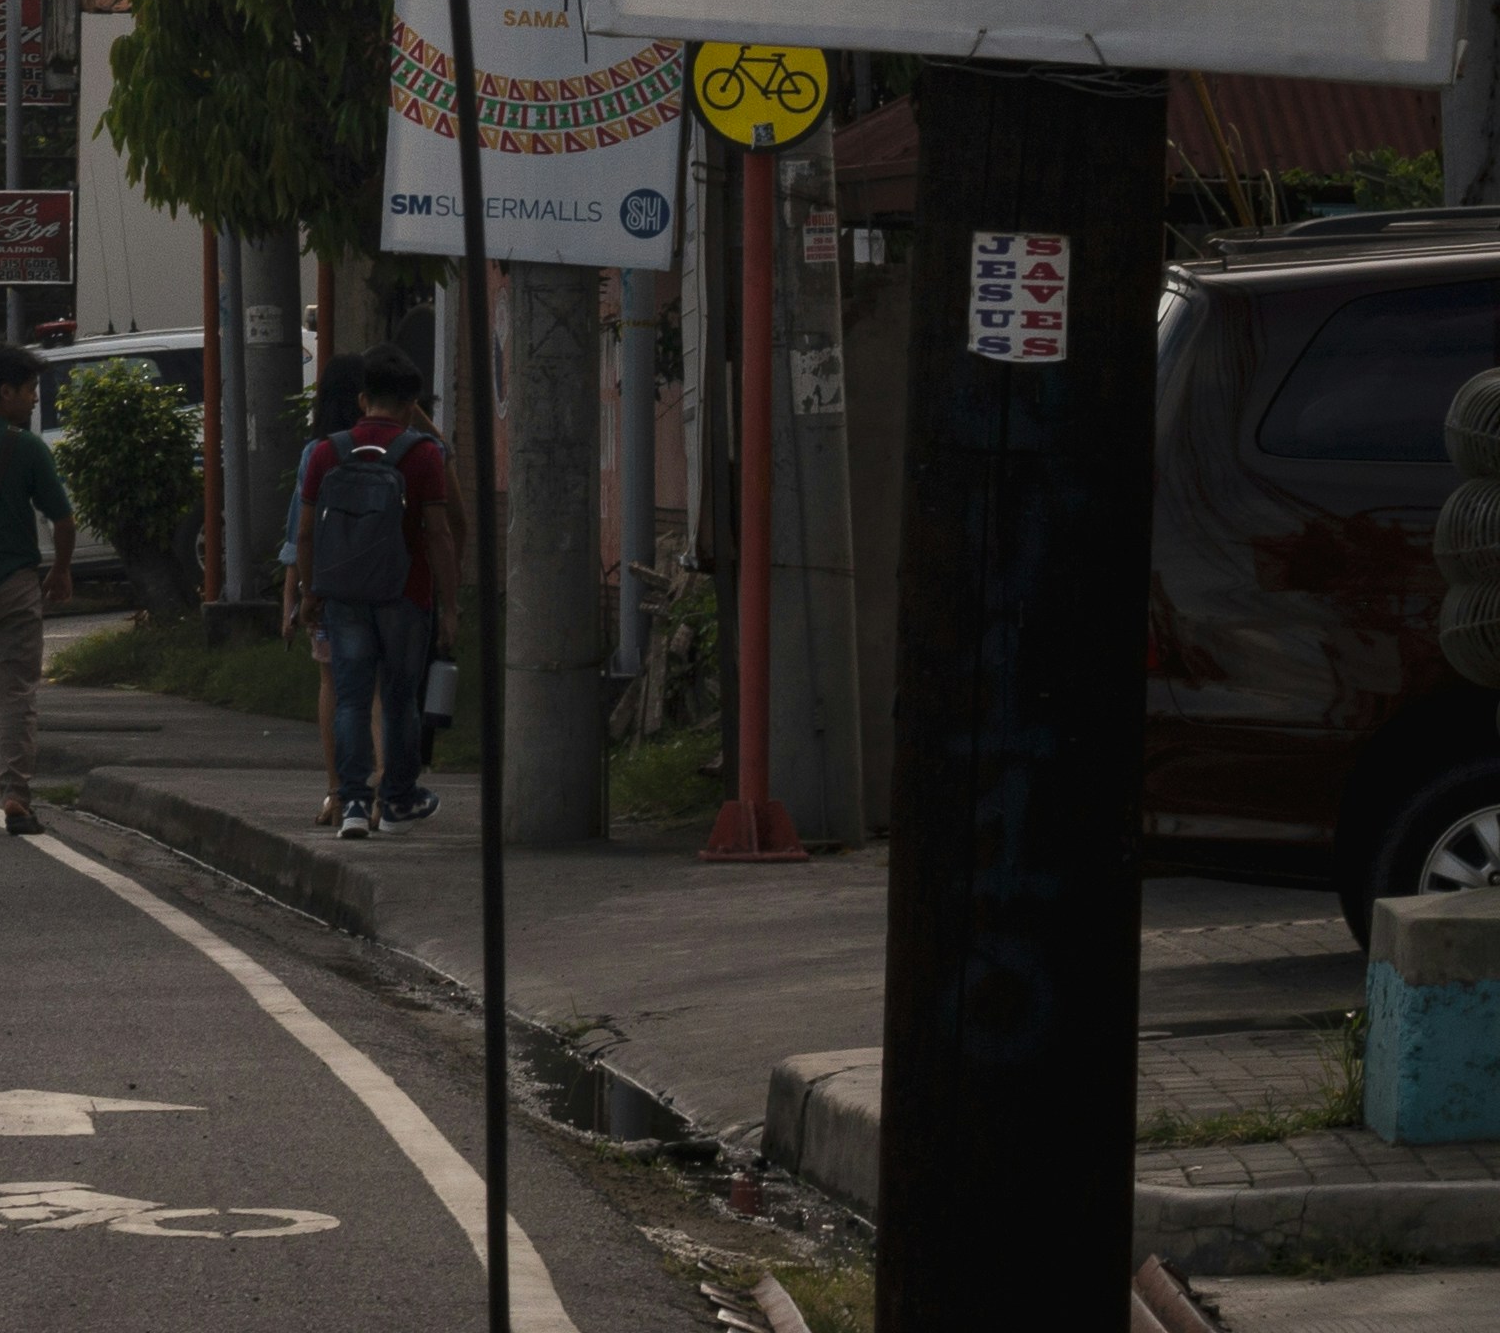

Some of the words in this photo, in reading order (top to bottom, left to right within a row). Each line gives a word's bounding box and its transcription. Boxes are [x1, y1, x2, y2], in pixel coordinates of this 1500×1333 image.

[504, 9, 570, 29] SAMA
[390, 194, 432, 216] SM
[435, 195, 603, 223] SUERMALLS
[626, 195, 661, 231] SM
[975, 236, 1017, 355] JESUS
[1020, 237, 1066, 357] SAVES
